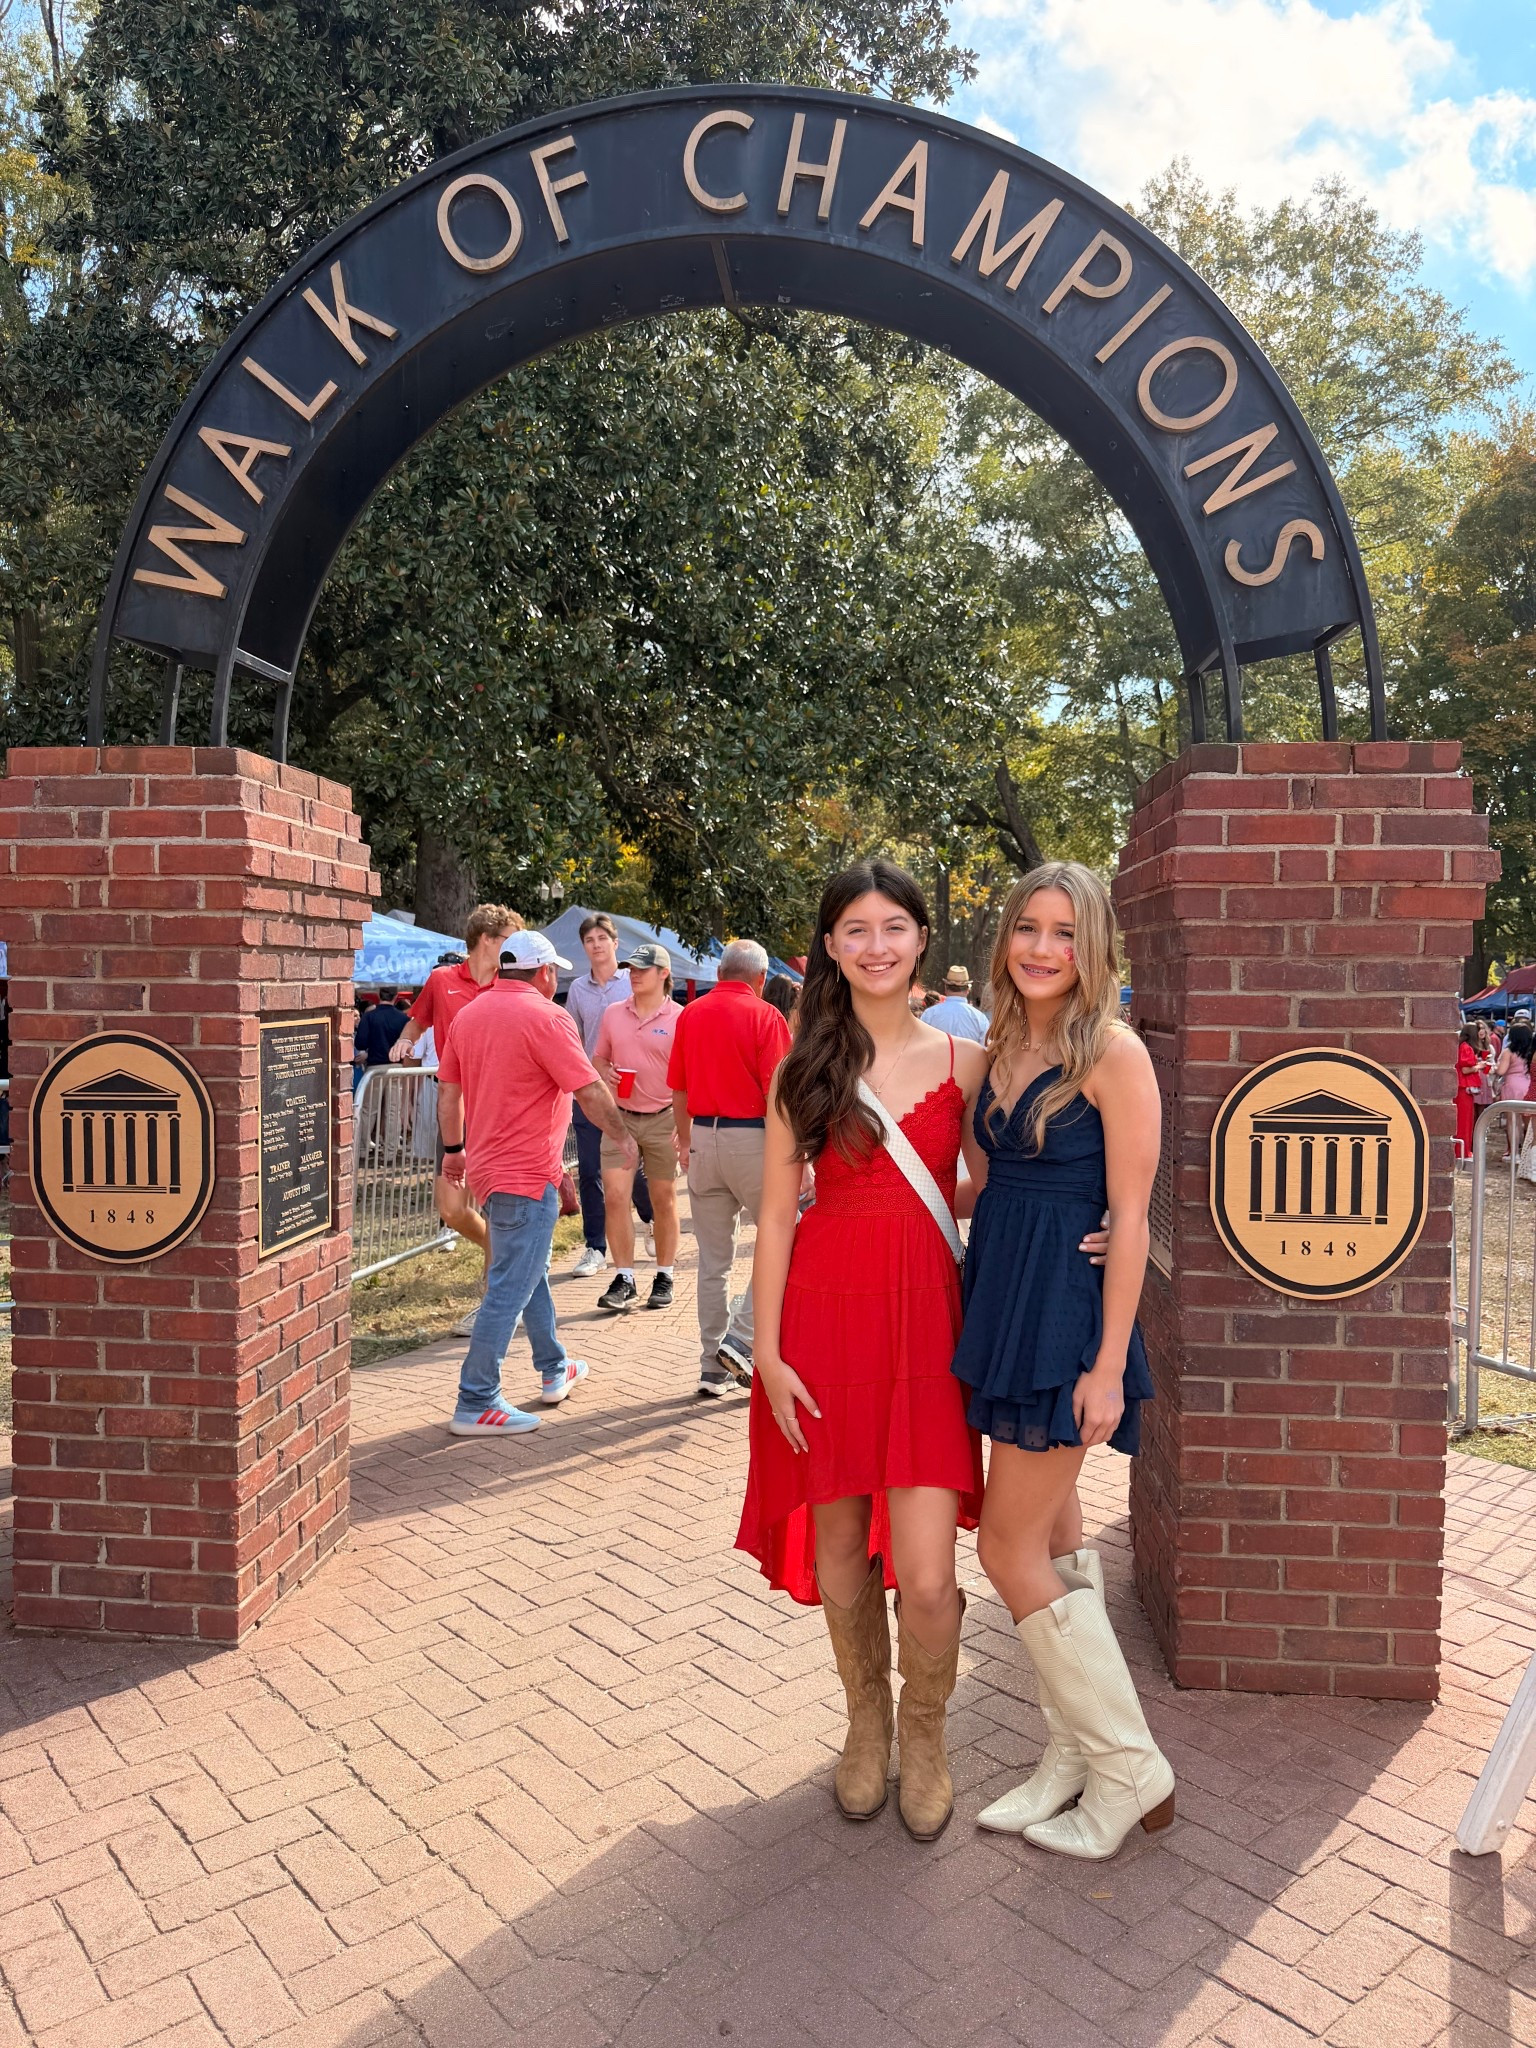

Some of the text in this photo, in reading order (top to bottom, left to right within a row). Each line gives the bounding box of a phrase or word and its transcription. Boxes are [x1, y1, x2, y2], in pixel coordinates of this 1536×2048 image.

[132, 109, 1324, 599] WALK OF CHAMPIONS
[269, 1160, 291, 1175] TRAINER
[90, 1209, 155, 1224] 1848
[1280, 1240, 1357, 1257] 1848
